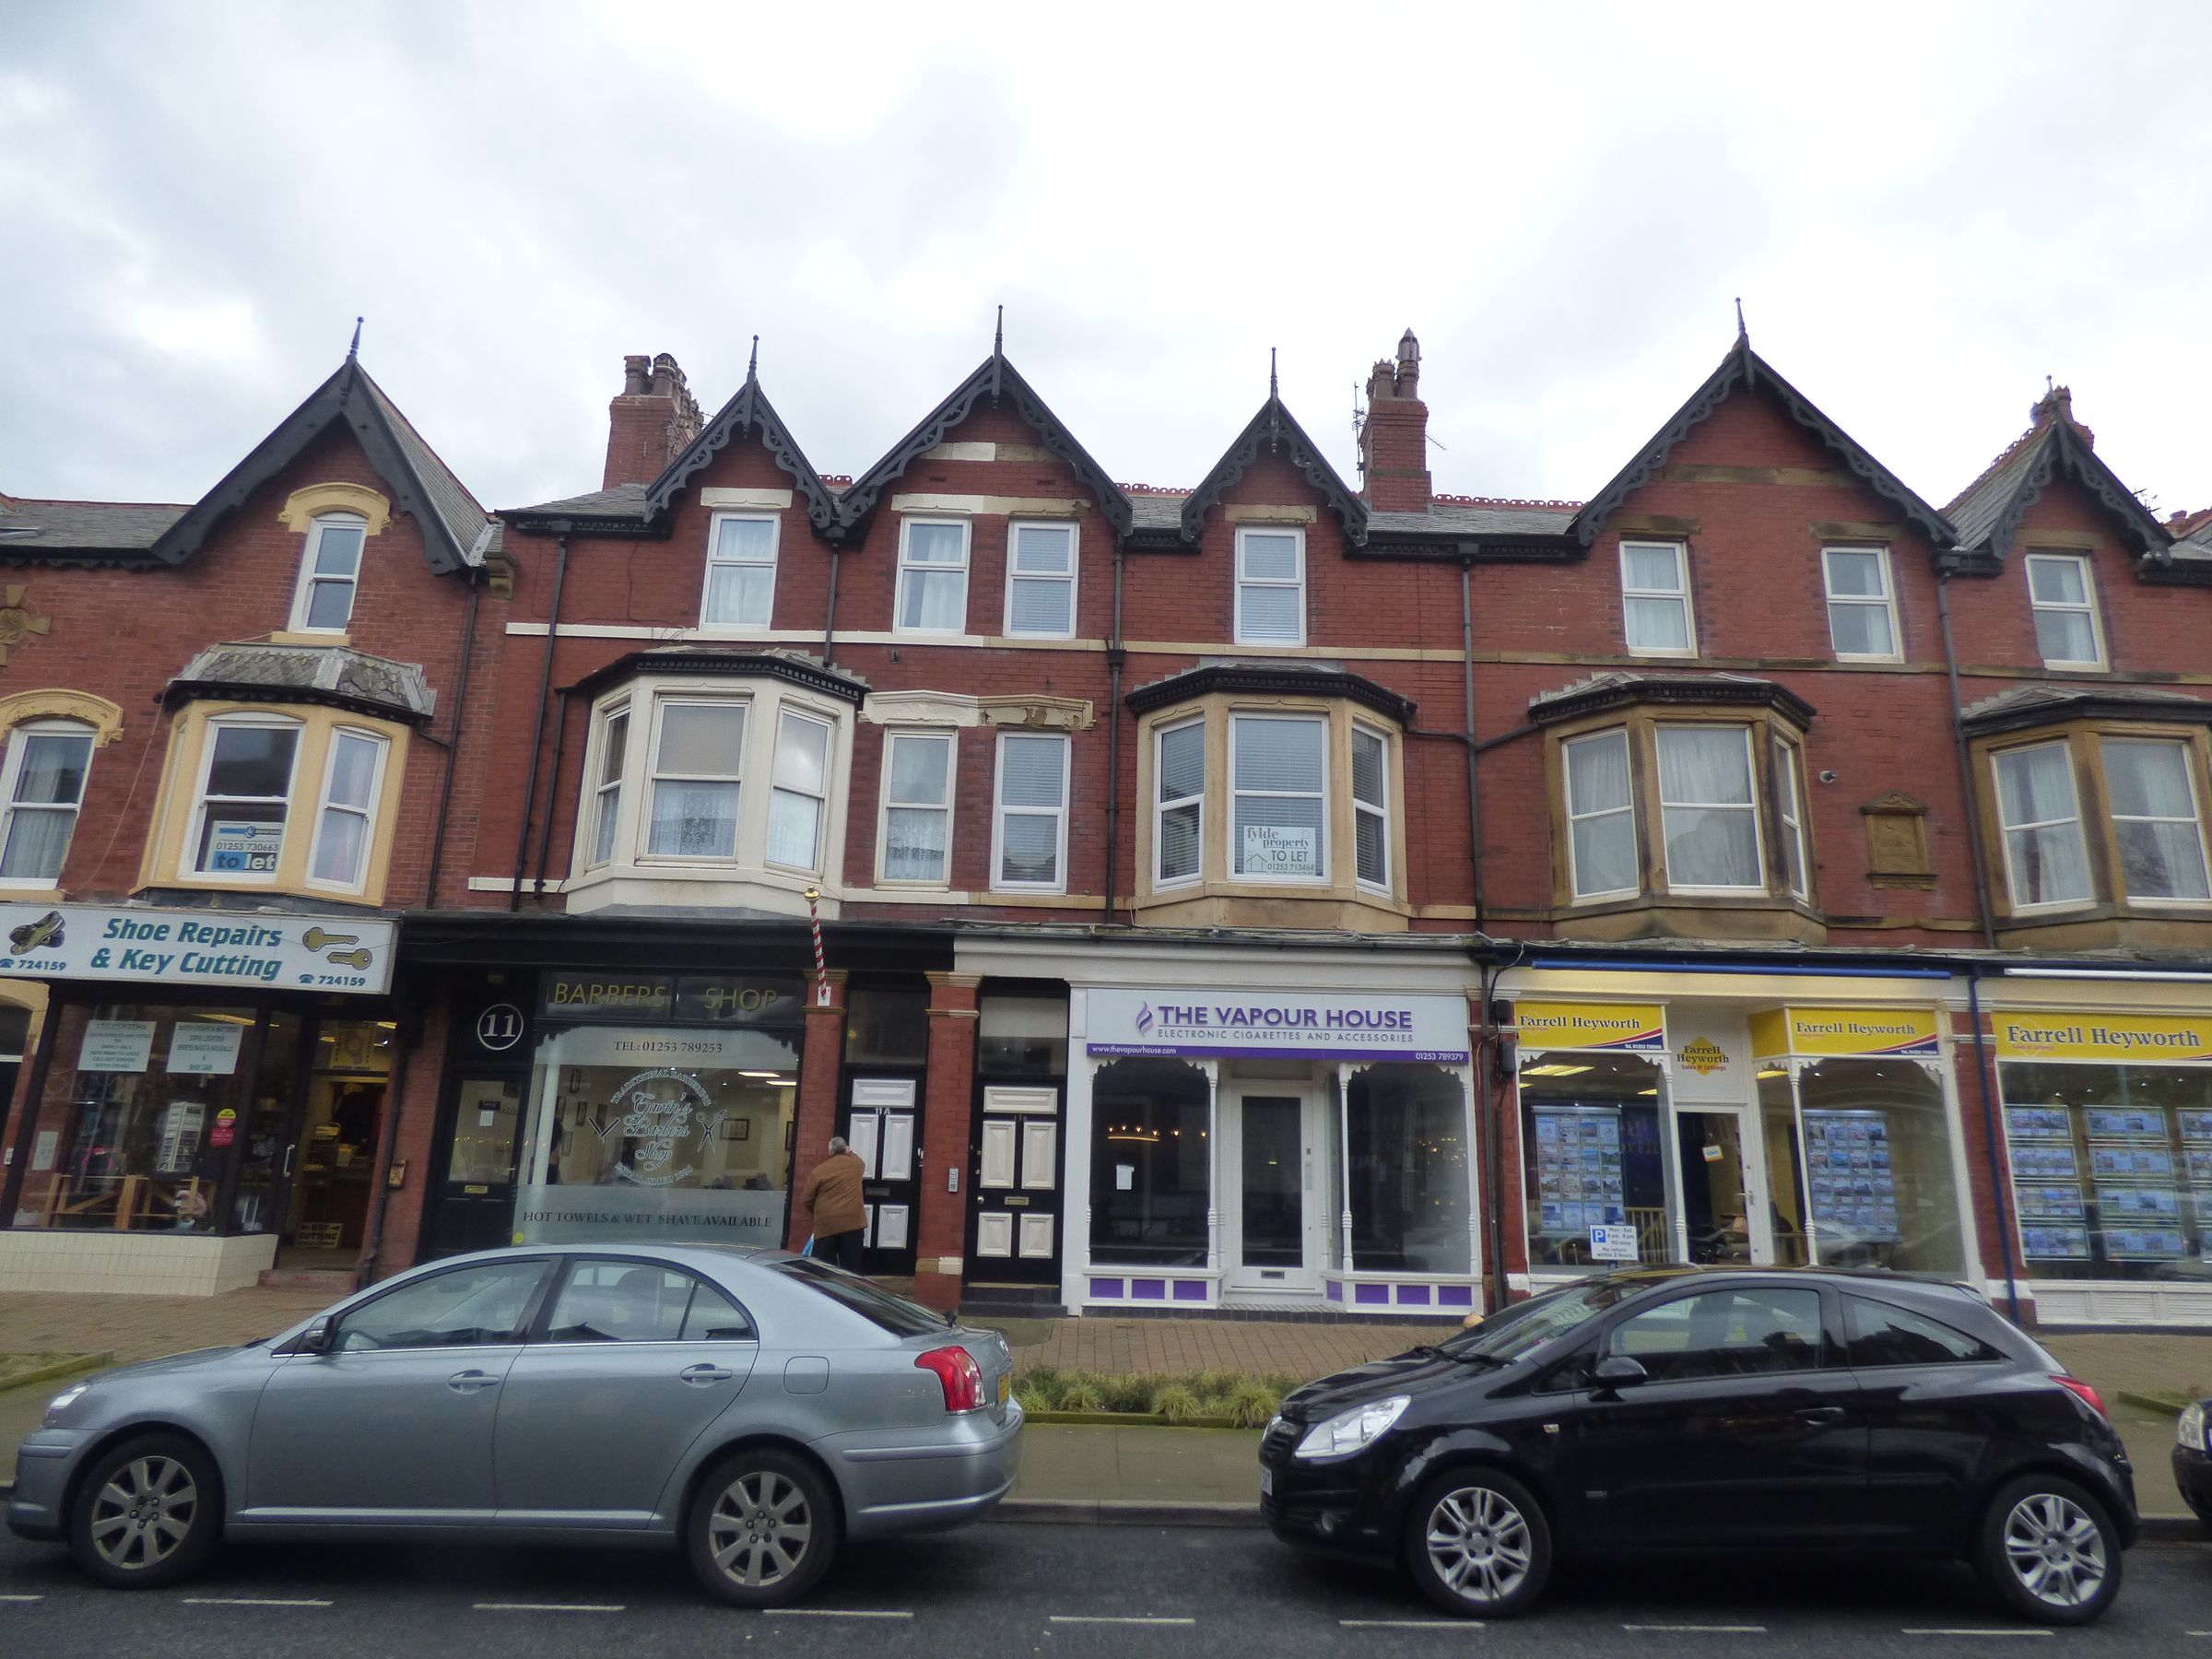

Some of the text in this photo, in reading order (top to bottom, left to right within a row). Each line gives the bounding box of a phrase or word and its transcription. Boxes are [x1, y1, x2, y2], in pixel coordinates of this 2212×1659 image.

[1247, 827, 1278, 841] fylde
[216, 841, 279, 852] 01253 730663
[1263, 839, 1309, 850] property
[218, 853, 276, 870] to let
[1271, 850, 1308, 863] TO LET
[1267, 863, 1288, 871] 01253
[103, 918, 283, 947] Shoe Repairs
[18, 959, 66, 971] 724159
[90, 947, 283, 982] & Key Cutting
[318, 975, 366, 987] 724159
[553, 982, 778, 1011] BARBERS SHOP
[1158, 1006, 1413, 1030] THE VAPOUR HOUSE
[1520, 1016, 1641, 1030] Farrell Heyworth
[483, 1014, 516, 1038] 11
[1796, 1022, 1916, 1036] Farrell Heyworth
[1158, 1030, 1414, 1043] ELECTRONIC CIGARETTES AND ACCESSORIES
[2006, 1026, 2201, 1048] Farrell Heyworth
[614, 1041, 723, 1053] TEL: 01253 789253
[1092, 1045, 1177, 1054] www.thevapourhouse.com
[1684, 1045, 1721, 1053] Farrell
[1415, 1052, 1464, 1062] 01253 789379
[1677, 1053, 1730, 1065] Heyworth
[610, 1069, 670, 1104] TRADITIONAL
[875, 1107, 891, 1115] 11A
[623, 1114, 691, 1137] Barbers
[634, 1138, 675, 1171] Shop
[523, 1211, 772, 1228] HOT TOWELS & WET SHAVE AVAILABLE
[1594, 1230, 1604, 1241] P
